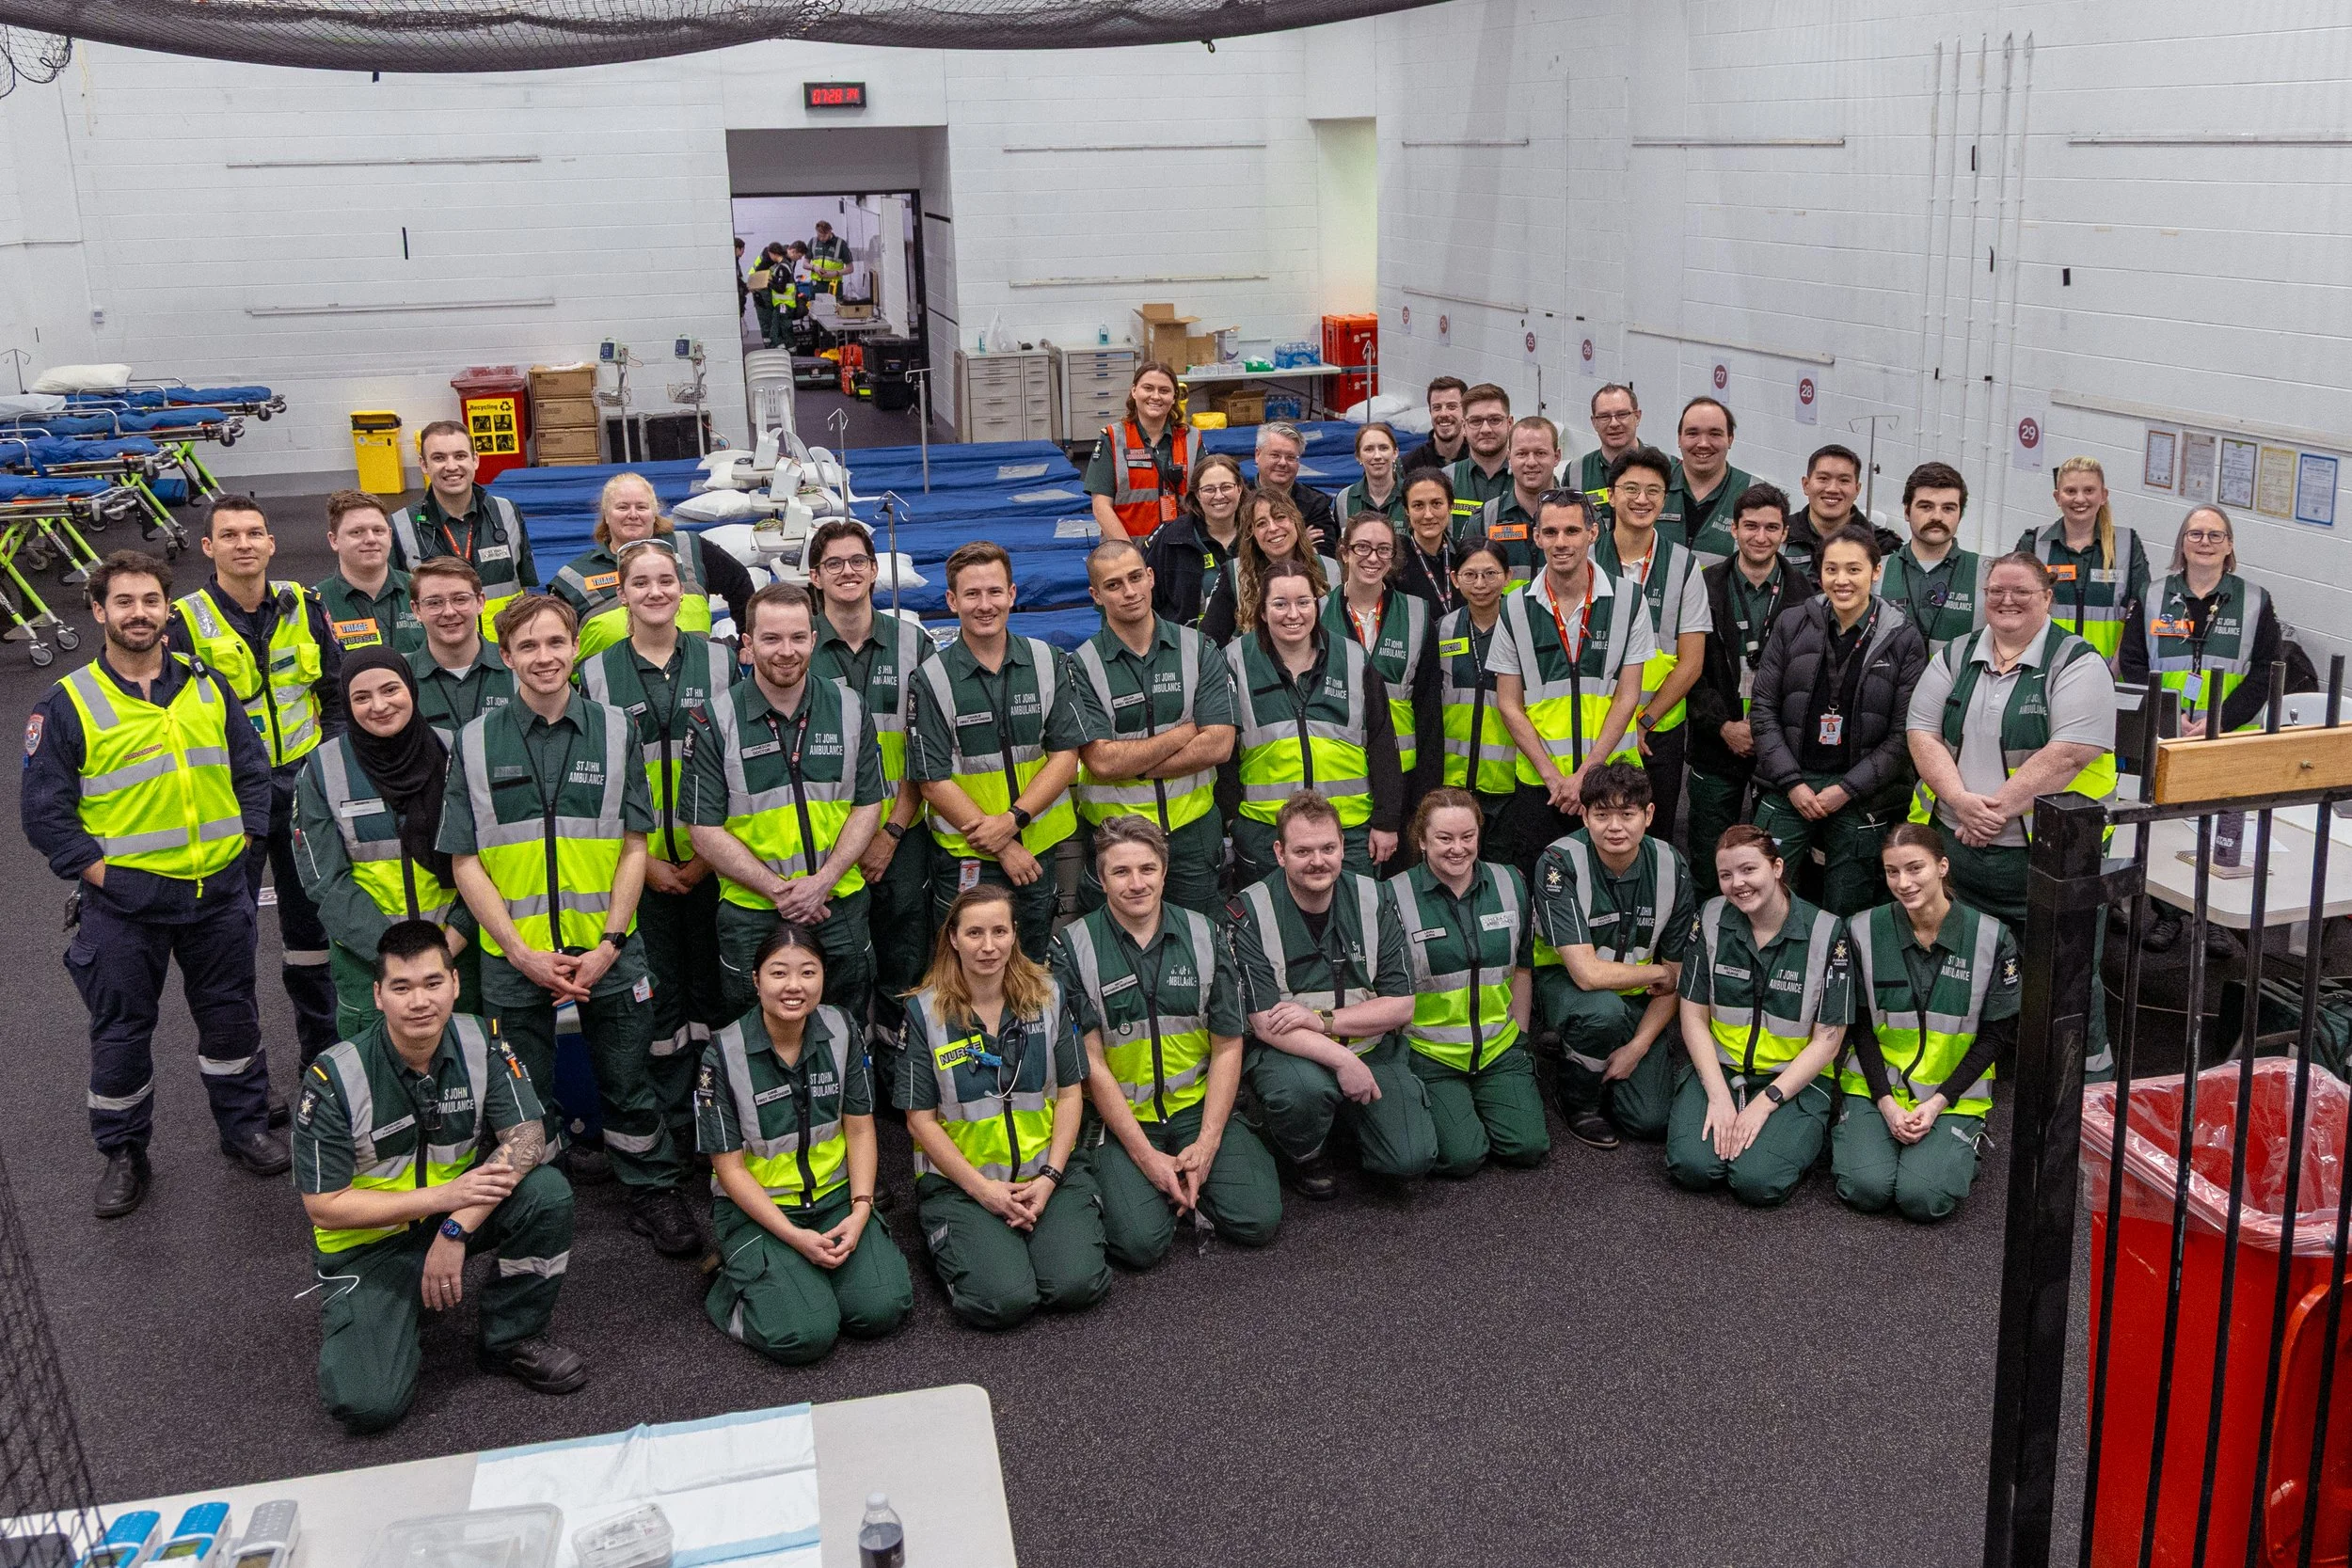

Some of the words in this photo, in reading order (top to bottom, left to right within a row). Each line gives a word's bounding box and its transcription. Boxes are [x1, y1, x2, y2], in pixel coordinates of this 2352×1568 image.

[1715, 371, 1725, 383] 27
[1802, 386, 1812, 398] 28
[469, 404, 498, 412] Recycling
[2022, 425, 2036, 440] 29
[593, 577, 616, 586] TRIAGE
[342, 623, 368, 633] TRIAGE
[1384, 638, 1391, 647] ST
[1391, 640, 1403, 649] JOHN
[1441, 642, 1462, 654] DOCTOR
[1378, 647, 1406, 659] AMBULANCE
[1154, 673, 1161, 683] ST
[1162, 672, 1176, 682] JOHN
[486, 696, 494, 705] ST
[1014, 694, 1021, 704] ST
[1022, 693, 1036, 704] JOHN
[1010, 704, 1041, 716] AMBULANCE
[815, 734, 822, 743] ST
[822, 734, 838, 744] JOHN
[809, 745, 843, 755] AMBULANCE
[576, 761, 584, 771] ST
[1783, 970, 1799, 981] JOHN
[1769, 978, 1803, 993] AMBULANCE
[939, 1042, 982, 1066] NURSE
[810, 1074, 818, 1085] ST
[818, 1071, 833, 1084] JOHN
[450, 1087, 469, 1100] JOHN
[769, 1090, 790, 1100] RESPONDER
